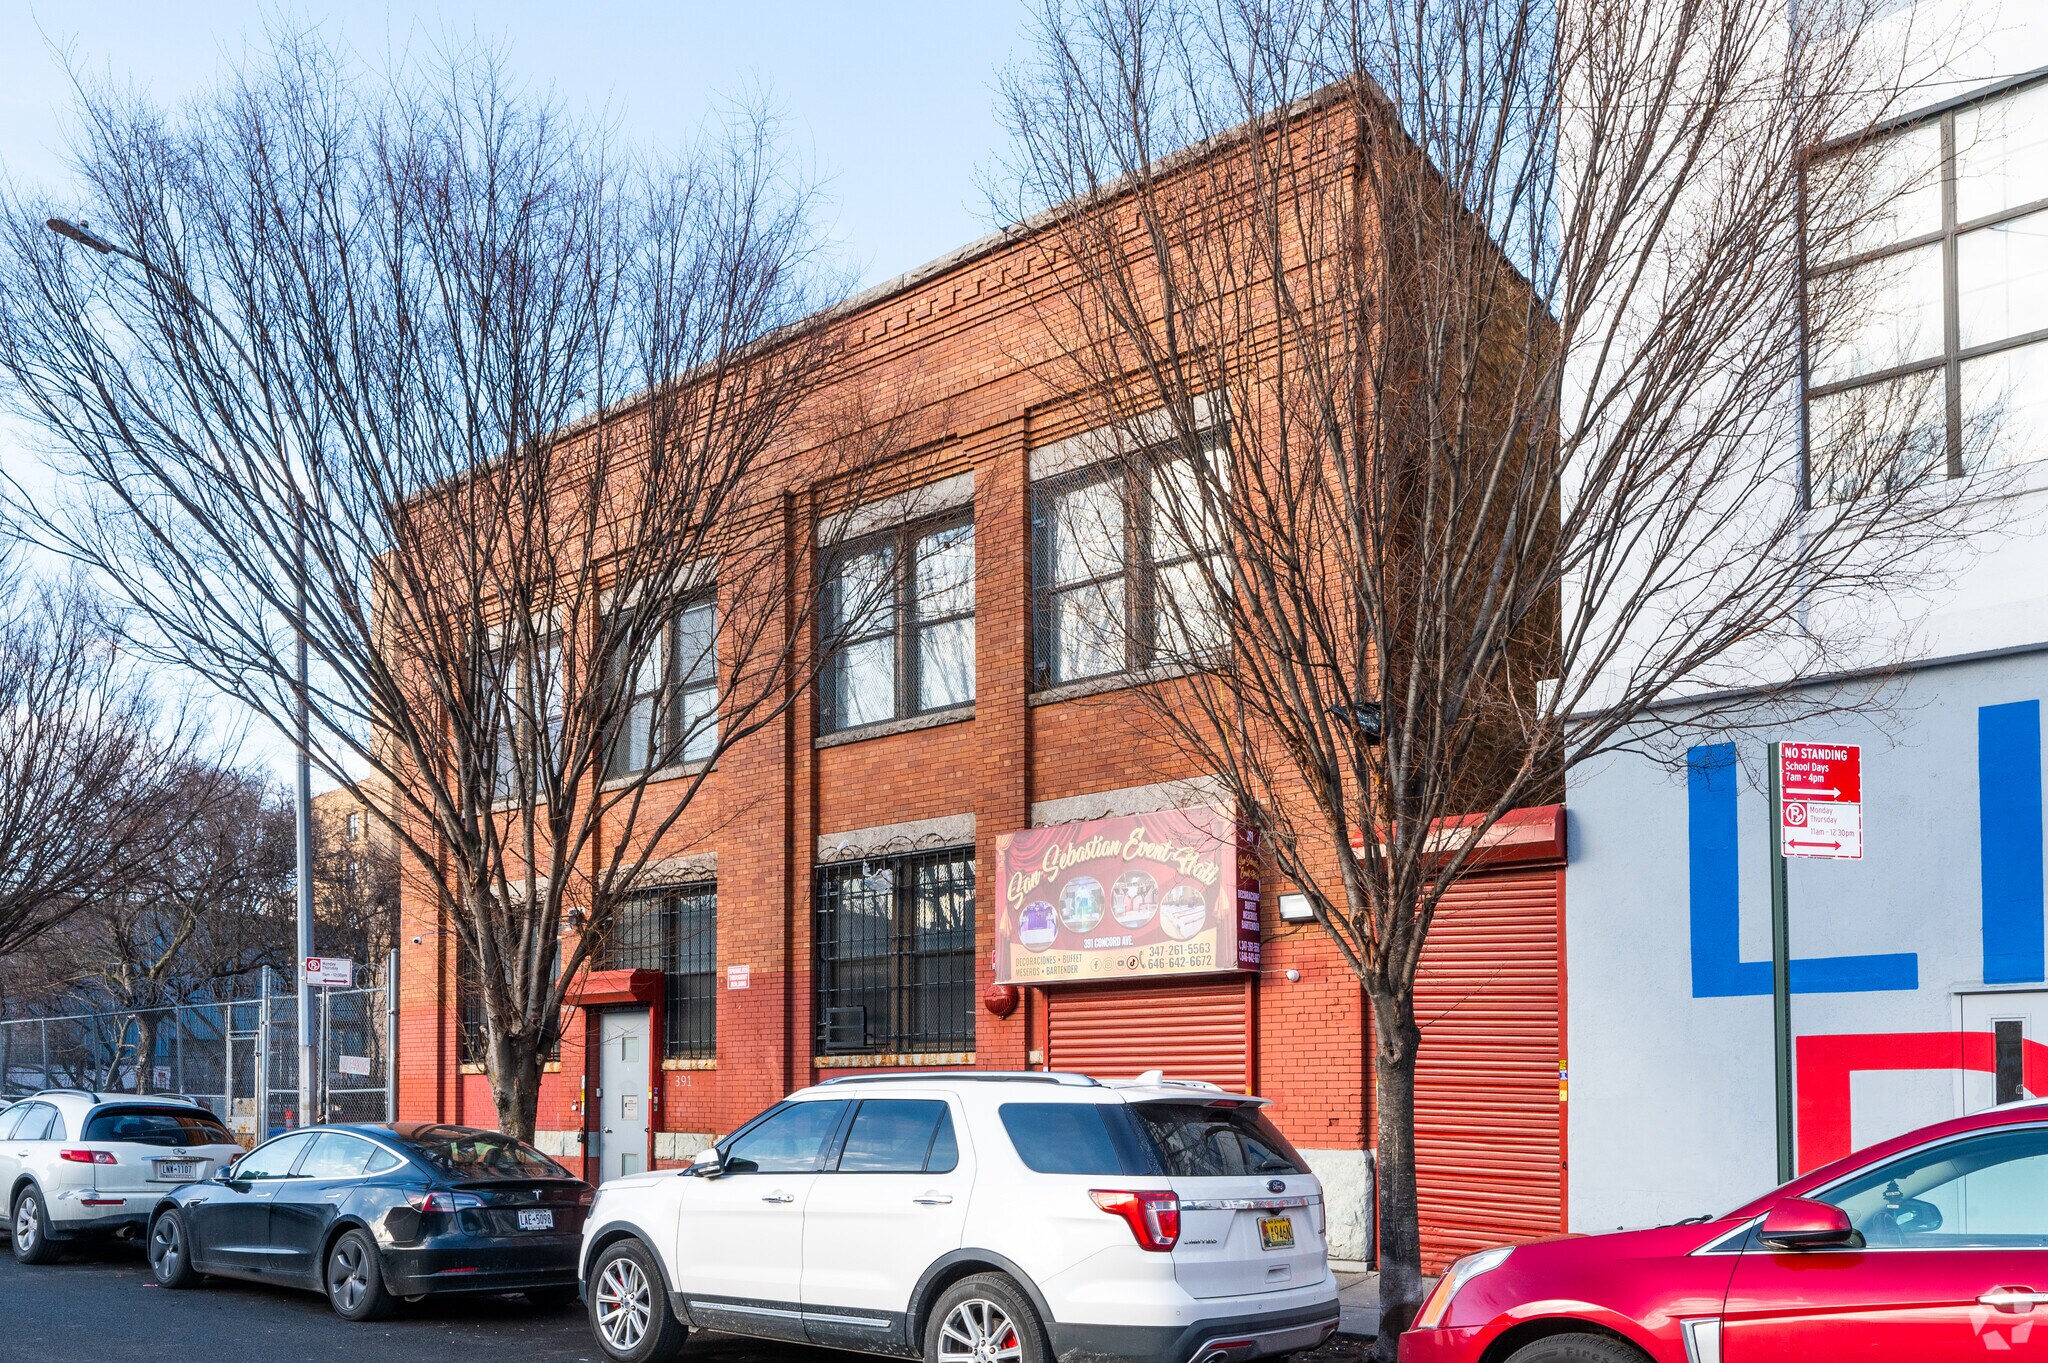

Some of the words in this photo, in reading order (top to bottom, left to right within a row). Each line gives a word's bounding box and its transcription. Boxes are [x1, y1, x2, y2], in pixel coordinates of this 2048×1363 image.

[1785, 747, 1799, 759] NO
[1801, 748, 1848, 761] STANDING
[1785, 761, 1810, 772] School
[1812, 762, 1829, 773] Days
[1785, 772, 1801, 782] 7am
[1808, 773, 1825, 784] 4pm
[1810, 806, 1833, 815] Monday
[1810, 816, 1838, 825] Thursday
[1810, 828, 1824, 836] 11am
[1007, 871, 1041, 910] San
[1042, 834, 1123, 882] Sebastian
[1122, 827, 1173, 863] Event
[1171, 846, 1219, 887] Hall
[1083, 938, 1094, 949] 391
[1094, 937, 1121, 948] CONCORD
[1121, 935, 1134, 946] AVE.
[1149, 942, 1211, 957] 347-261-5563
[1015, 956, 1057, 967] DECORACIONES
[1062, 954, 1082, 964] BUFFET
[1148, 955, 1212, 969] 646-642-6672
[1015, 967, 1040, 977] MESEROS
[1046, 965, 1078, 976] BARTENDER
[675, 1075, 692, 1087] 391
